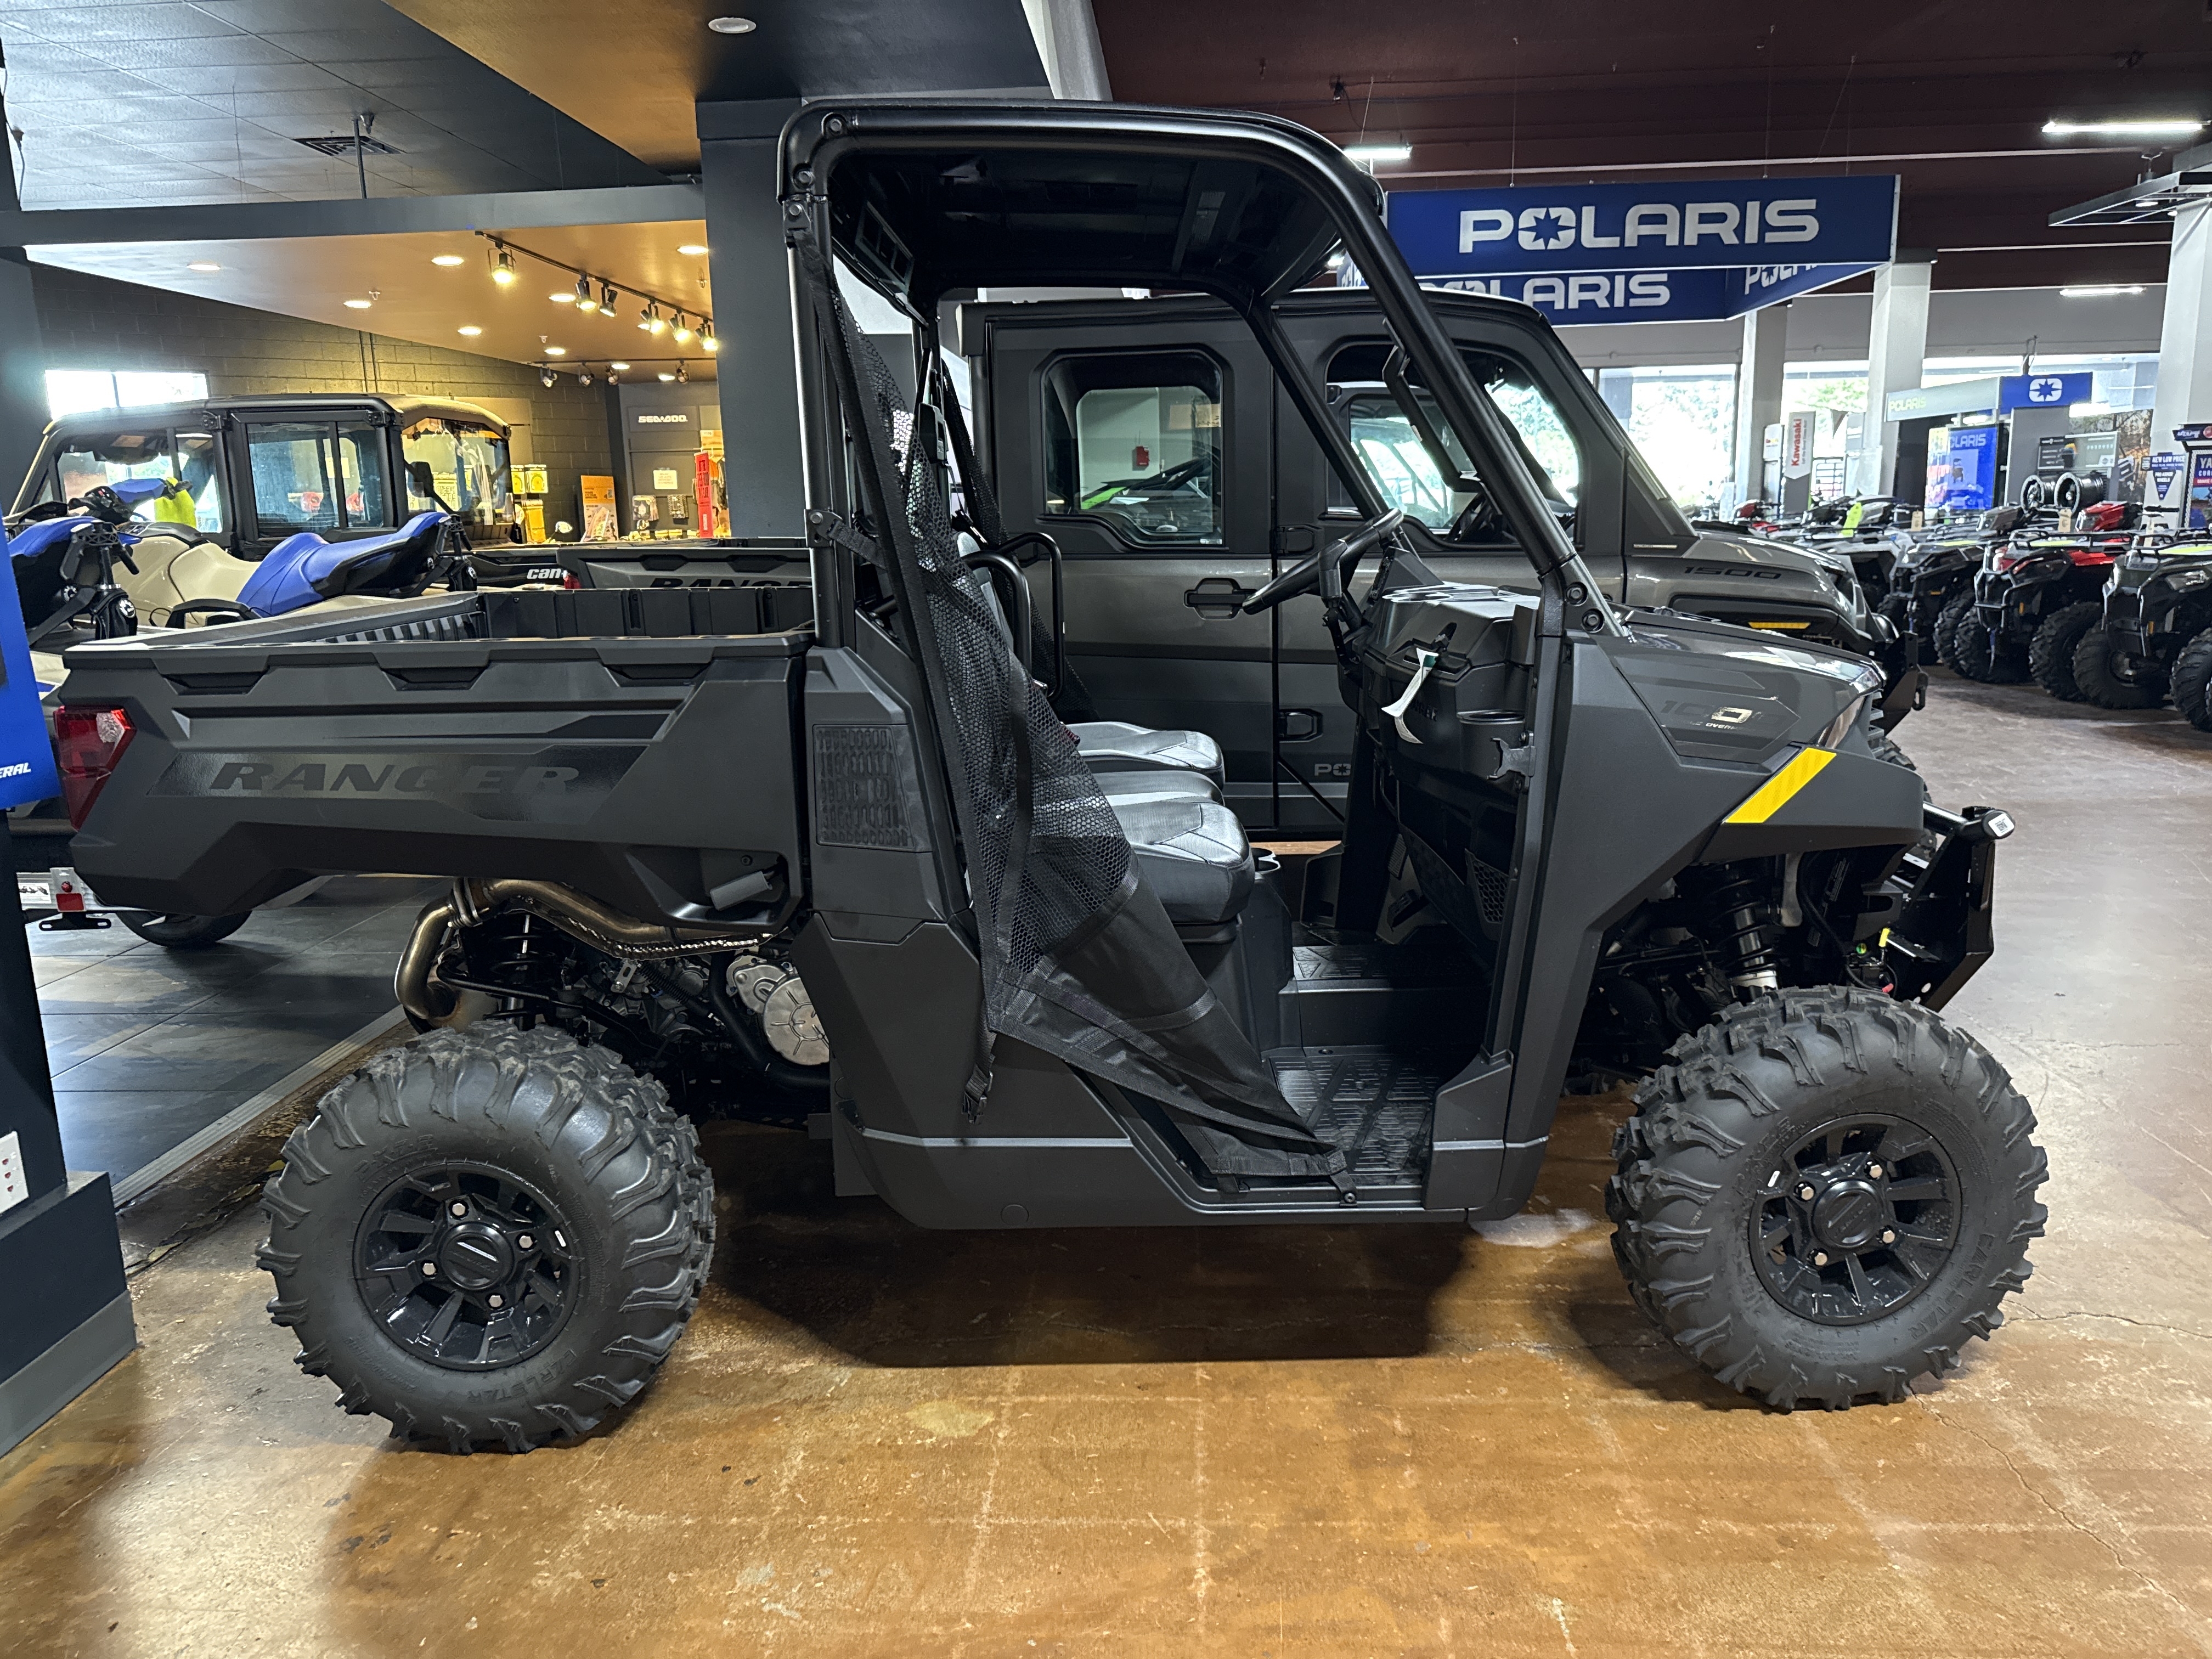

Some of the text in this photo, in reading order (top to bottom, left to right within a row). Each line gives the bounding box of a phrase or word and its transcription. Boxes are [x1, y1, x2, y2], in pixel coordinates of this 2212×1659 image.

[1459, 199, 1819, 253] POLARIS
[1888, 396, 1926, 413] POLARIS
[1791, 419, 1802, 466] Kawasaki
[1684, 567, 1782, 579] 1500
[210, 762, 579, 794] RANGER
